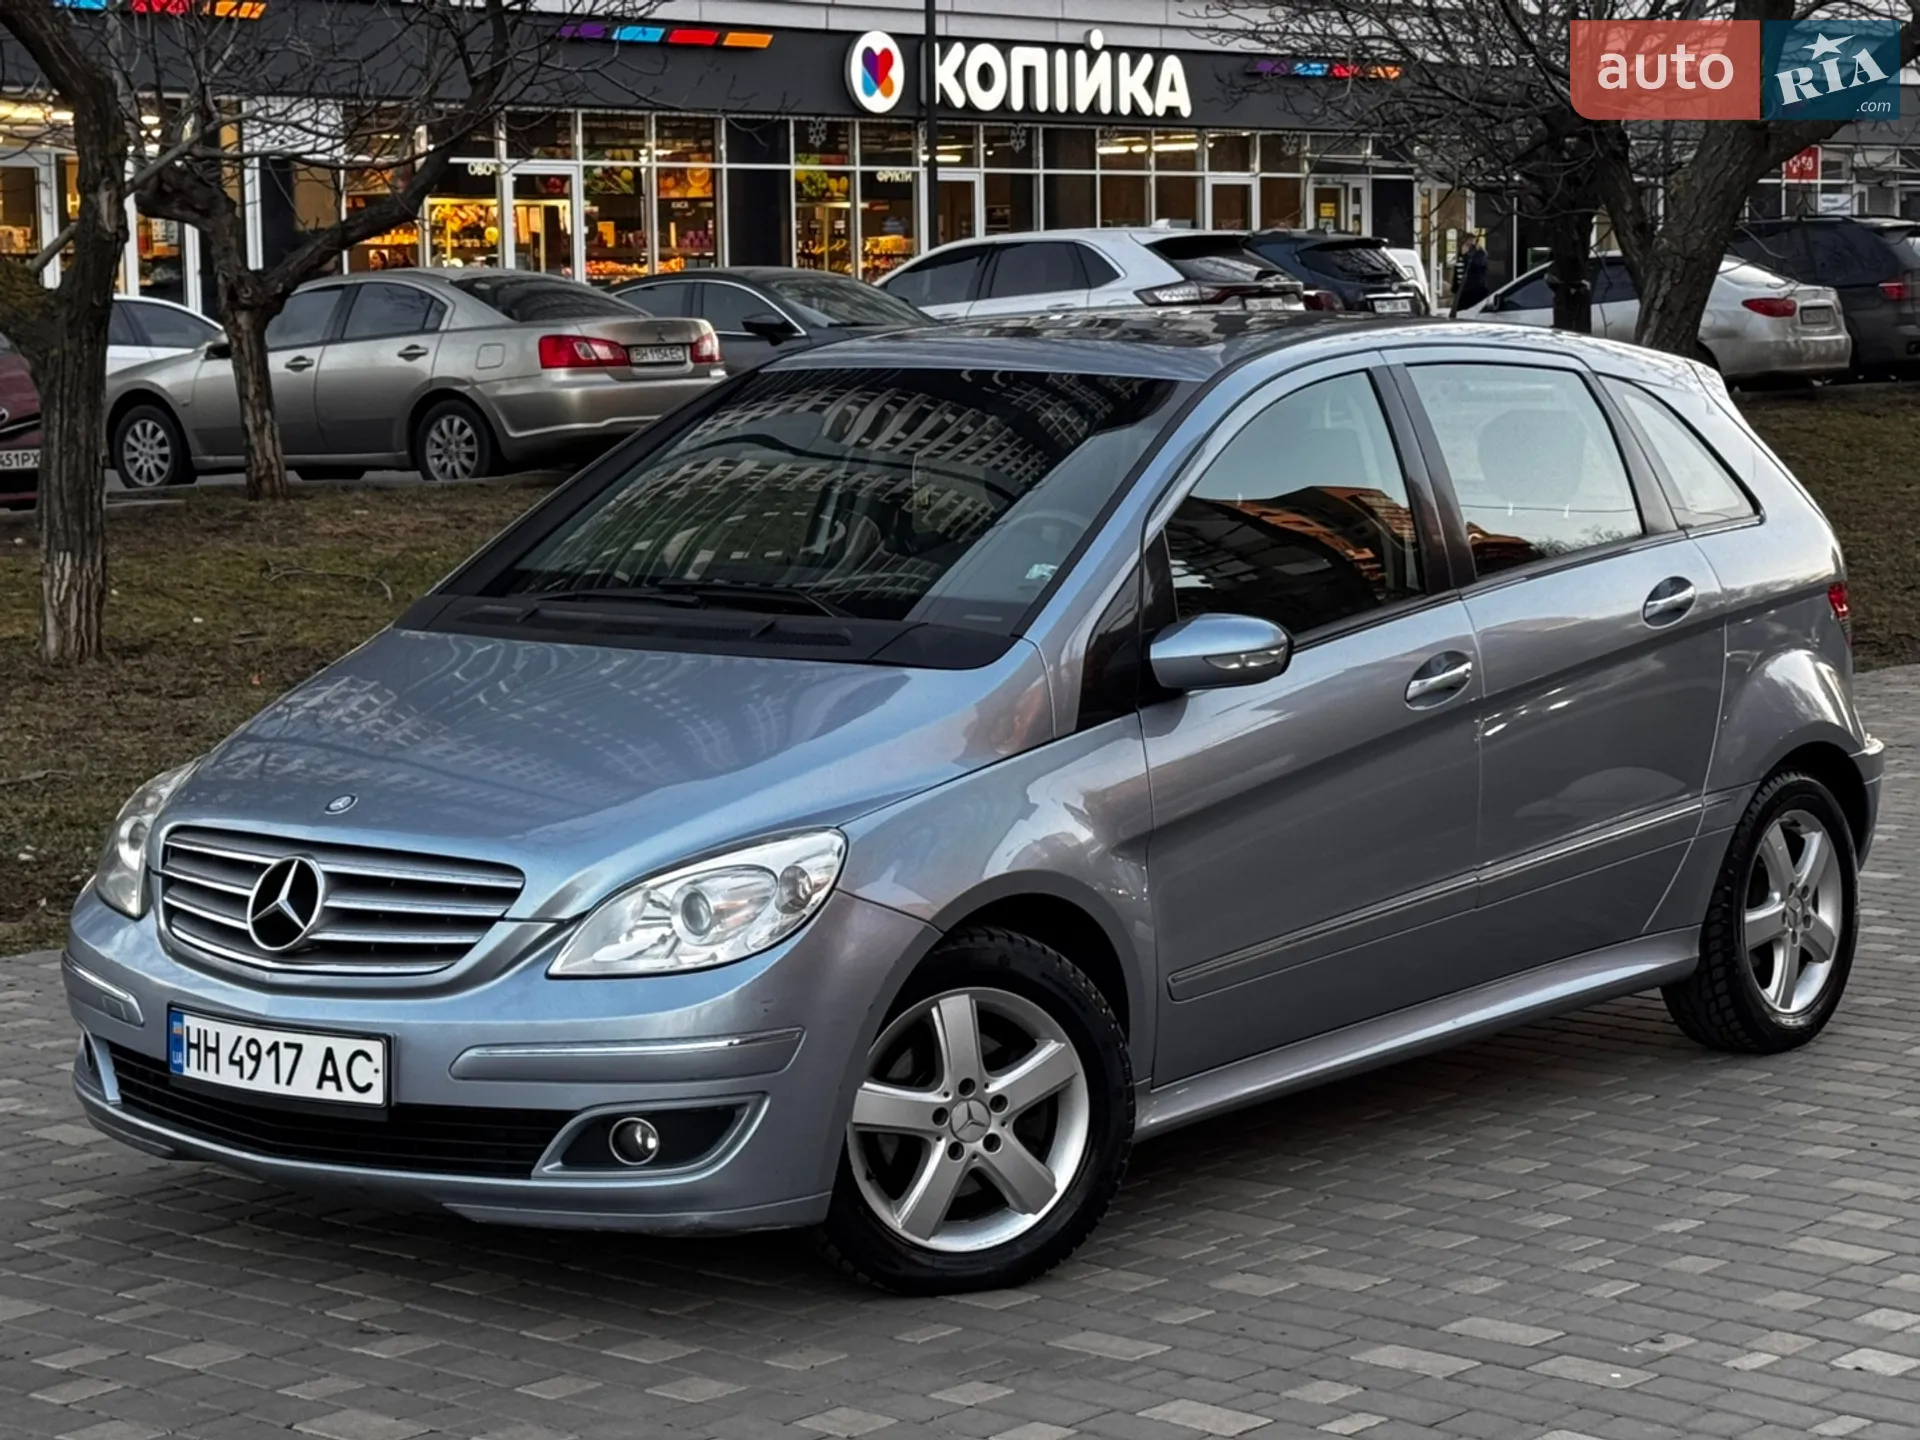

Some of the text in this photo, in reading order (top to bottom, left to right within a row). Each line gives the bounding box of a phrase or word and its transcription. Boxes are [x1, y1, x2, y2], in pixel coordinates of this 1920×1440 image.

[934, 28, 1192, 118] КОПІЙКА
[185, 1025, 375, 1094] HH 4917 AC
